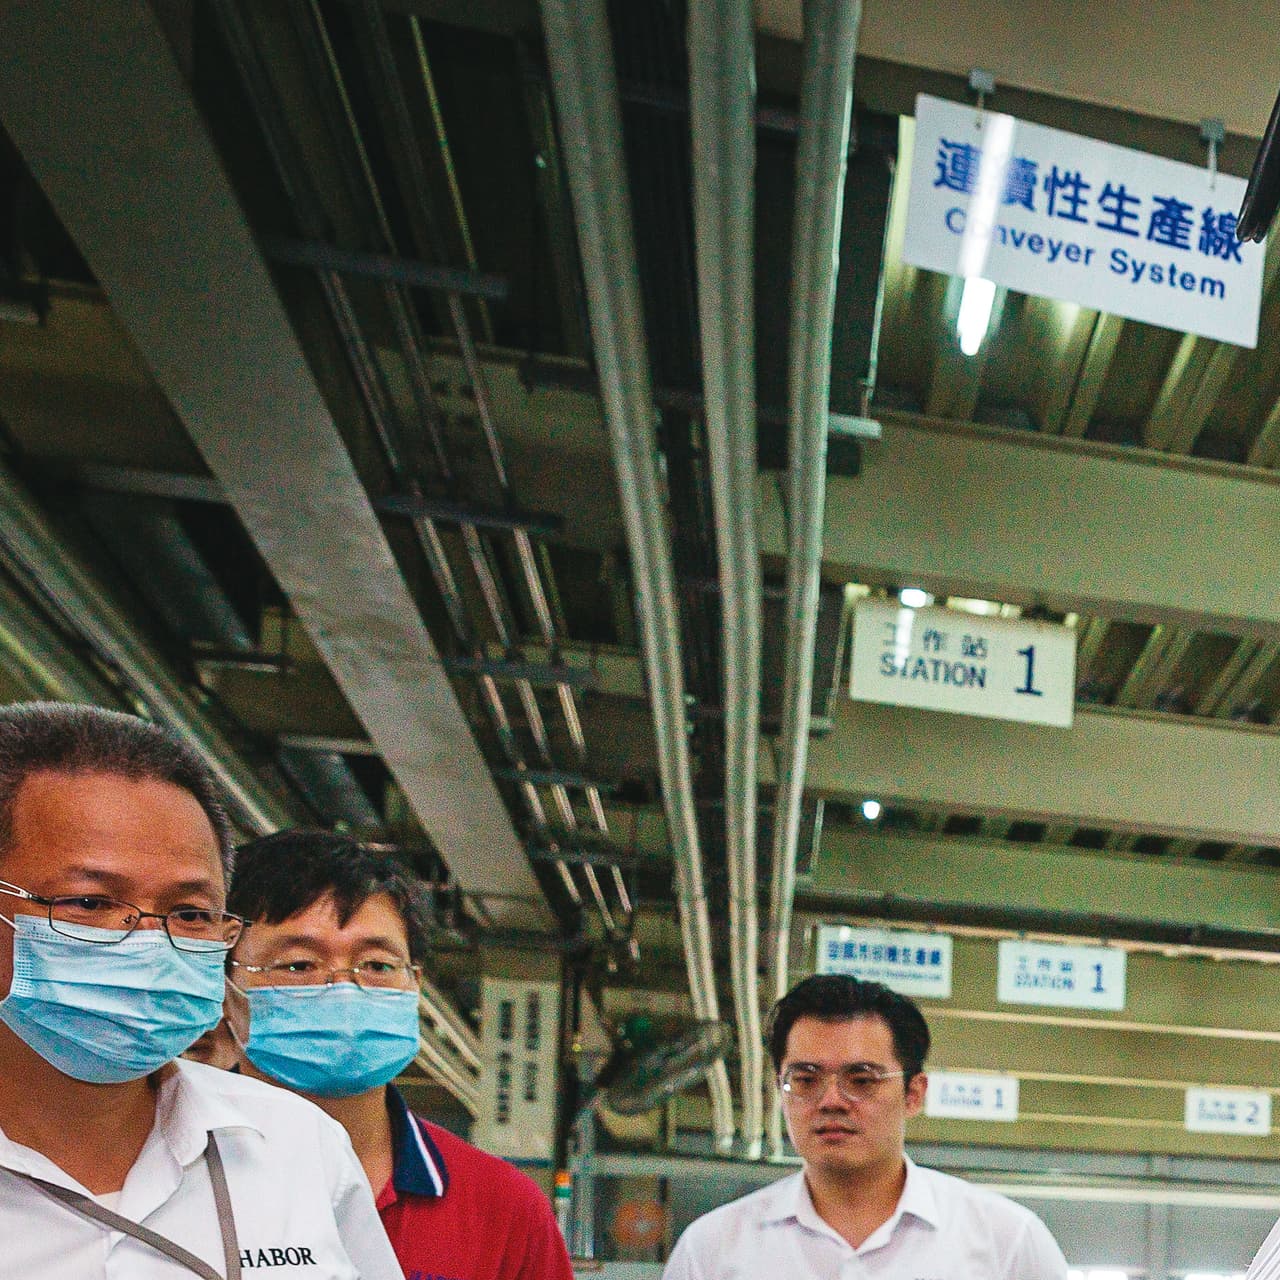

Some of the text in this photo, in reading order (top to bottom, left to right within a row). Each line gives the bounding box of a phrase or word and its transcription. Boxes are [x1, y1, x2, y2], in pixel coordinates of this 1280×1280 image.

[944, 207, 1226, 300] Cnveyer System
[1015, 644, 1043, 697] 1
[1092, 962, 1106, 994] 1
[239, 1246, 317, 1269] HABOR
